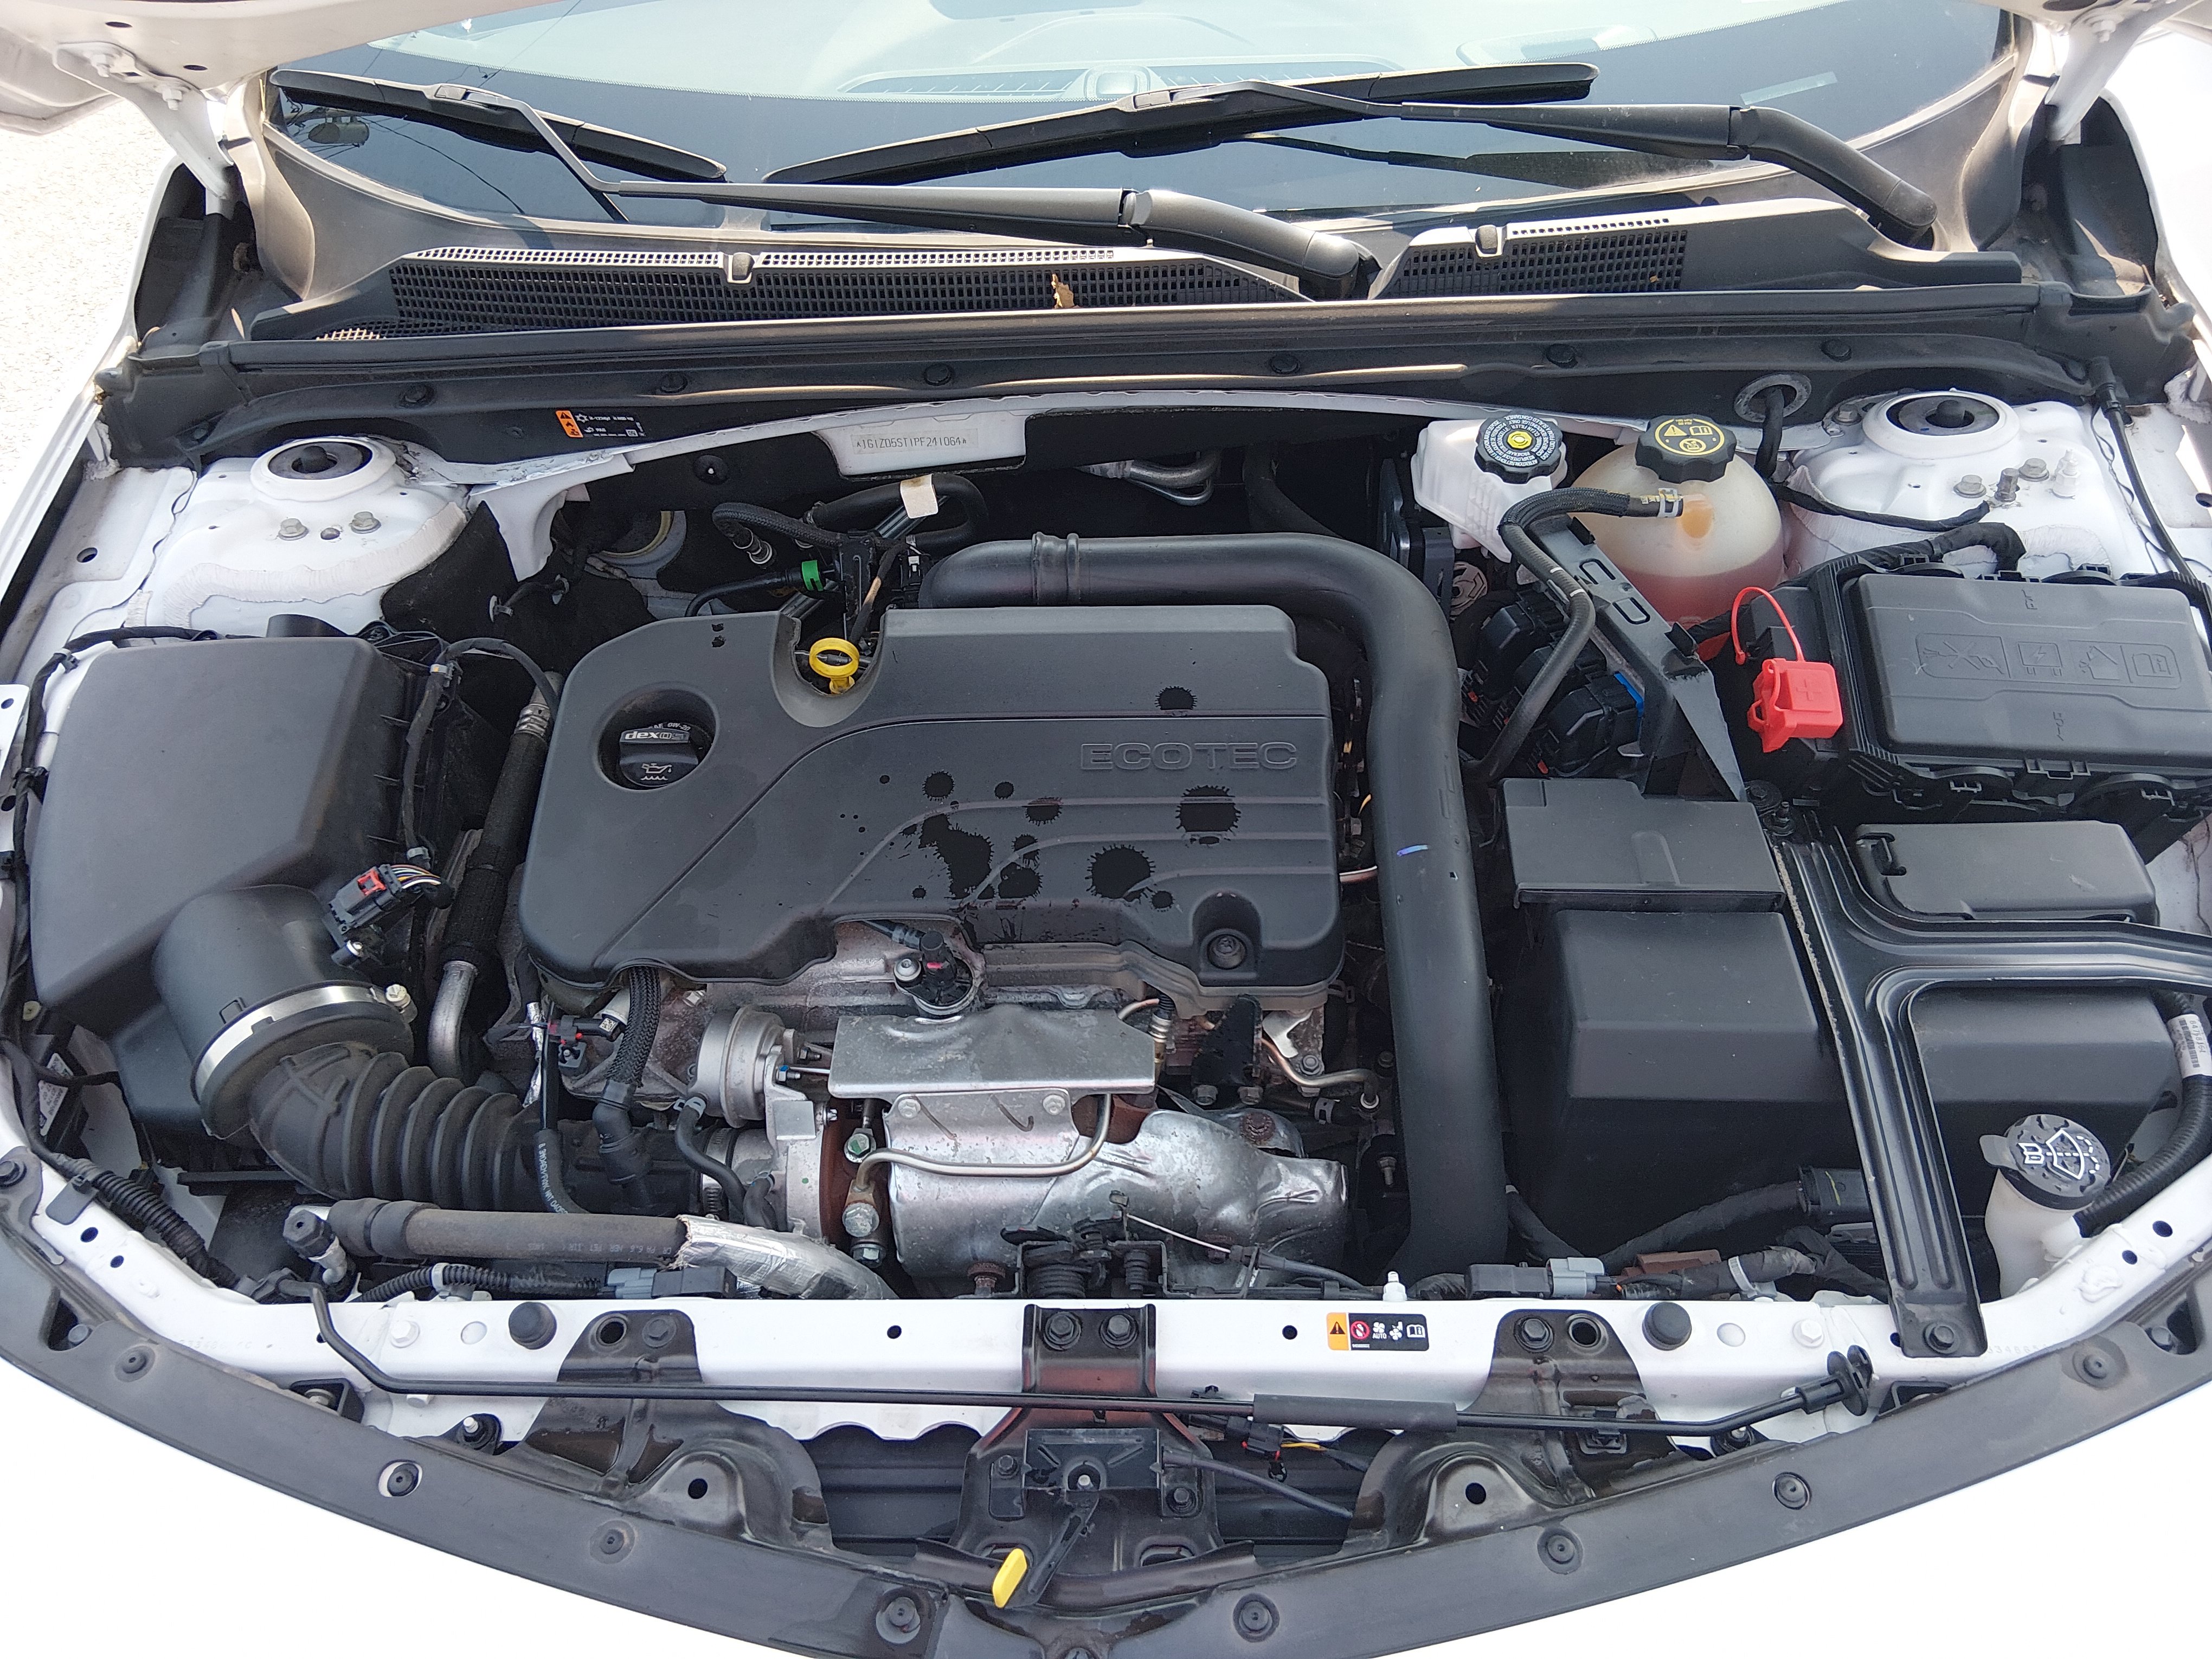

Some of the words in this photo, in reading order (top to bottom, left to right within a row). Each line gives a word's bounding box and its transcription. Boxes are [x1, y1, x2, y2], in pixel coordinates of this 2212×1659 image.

[667, 722, 691, 731] 0W-20
[625, 731, 684, 740] dexos
[1080, 742, 1297, 770] ECOTEC
